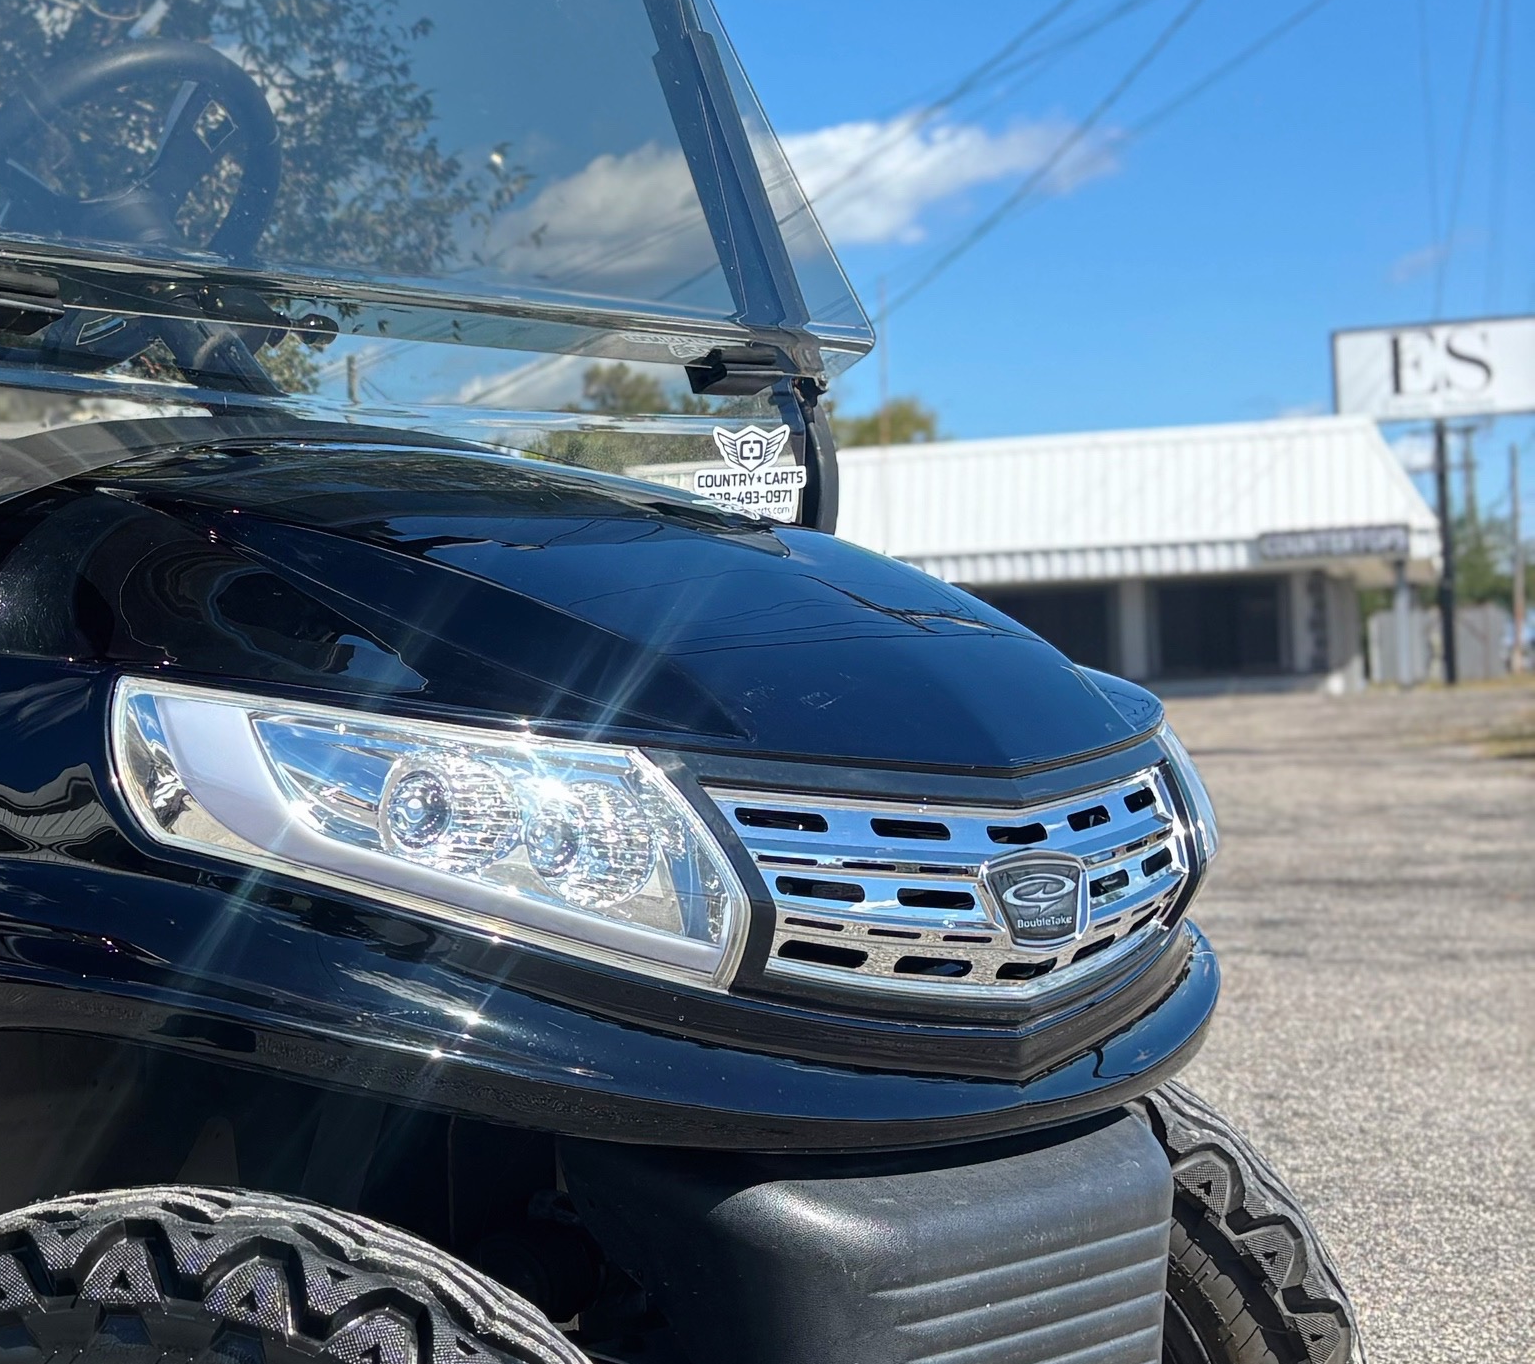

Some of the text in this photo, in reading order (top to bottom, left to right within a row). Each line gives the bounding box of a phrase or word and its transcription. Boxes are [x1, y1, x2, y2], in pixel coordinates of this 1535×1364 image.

[697, 470, 803, 488] COUNTRY CARTS
[1017, 915, 1073, 929] DoubleTake
